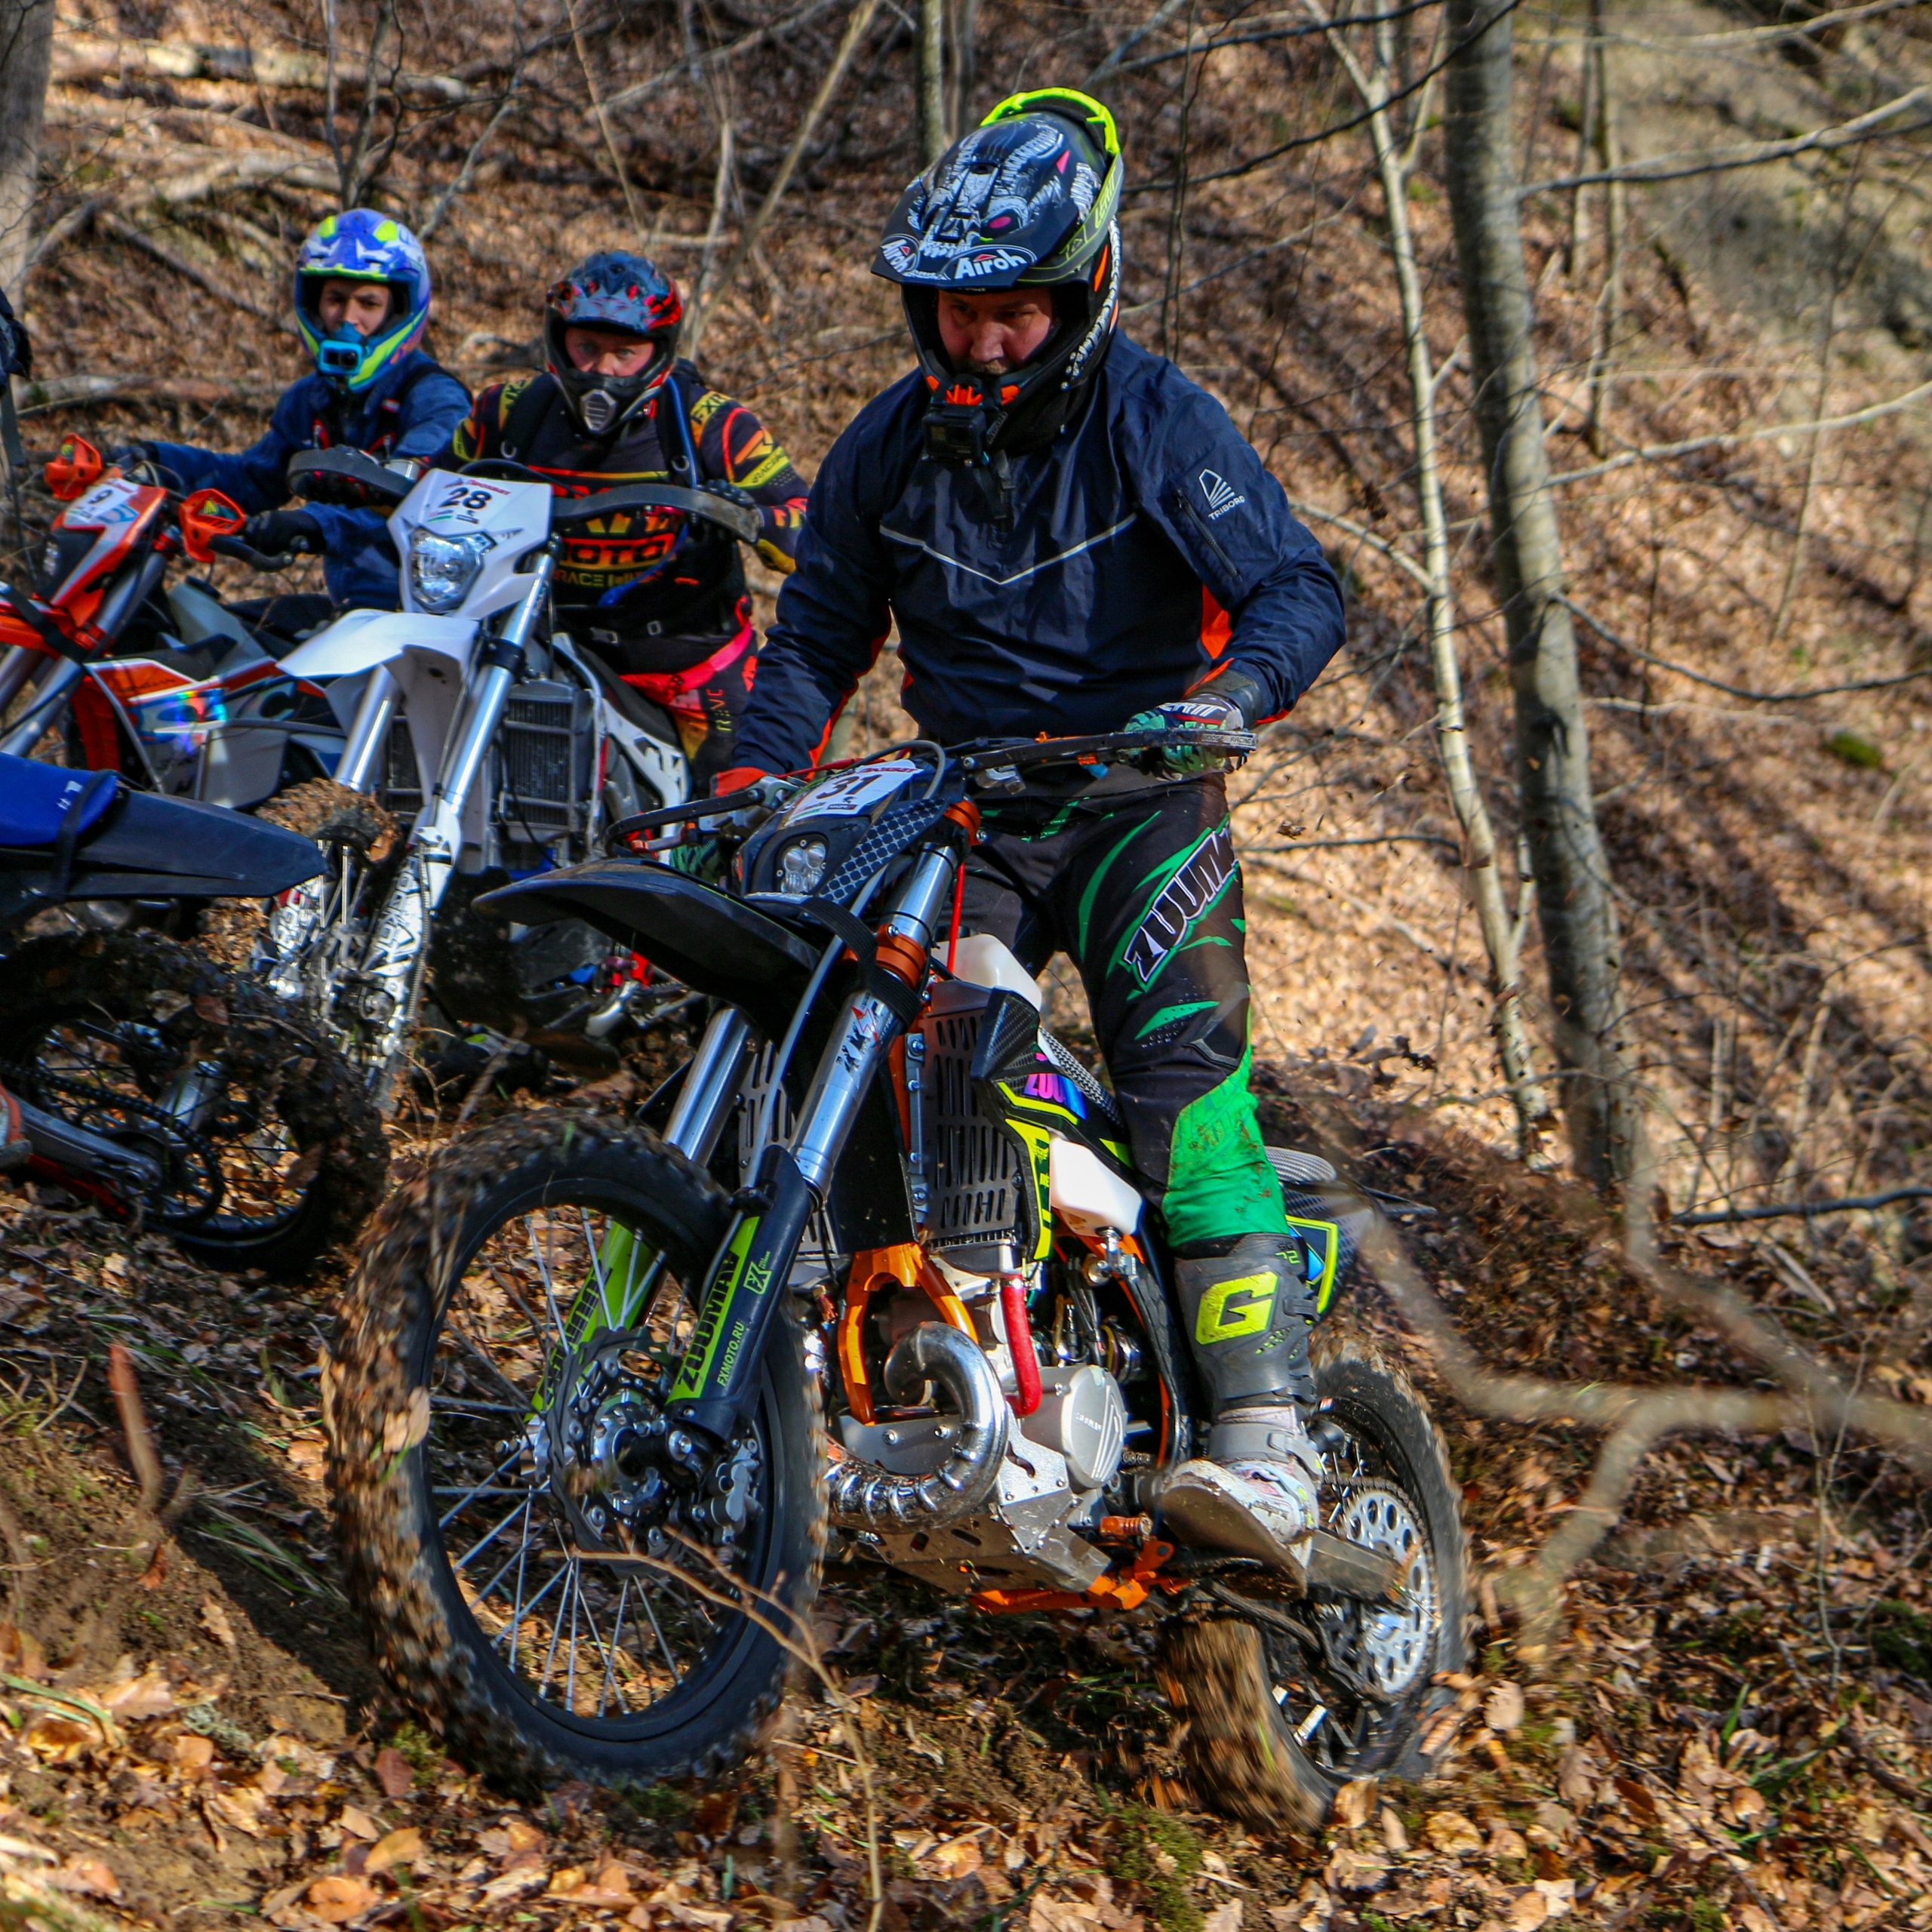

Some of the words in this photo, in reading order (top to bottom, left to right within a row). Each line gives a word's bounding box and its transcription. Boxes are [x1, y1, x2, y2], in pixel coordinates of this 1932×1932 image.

[881, 238, 916, 274] Airoh
[954, 248, 1027, 280] Airoh
[438, 487, 492, 509] 28
[1208, 495, 1245, 521] TRIBORD
[559, 538, 666, 565] OTO
[816, 768, 882, 800] 31
[1195, 1271, 1278, 1346] G
[717, 1320, 746, 1387] FXMOTO.RU
